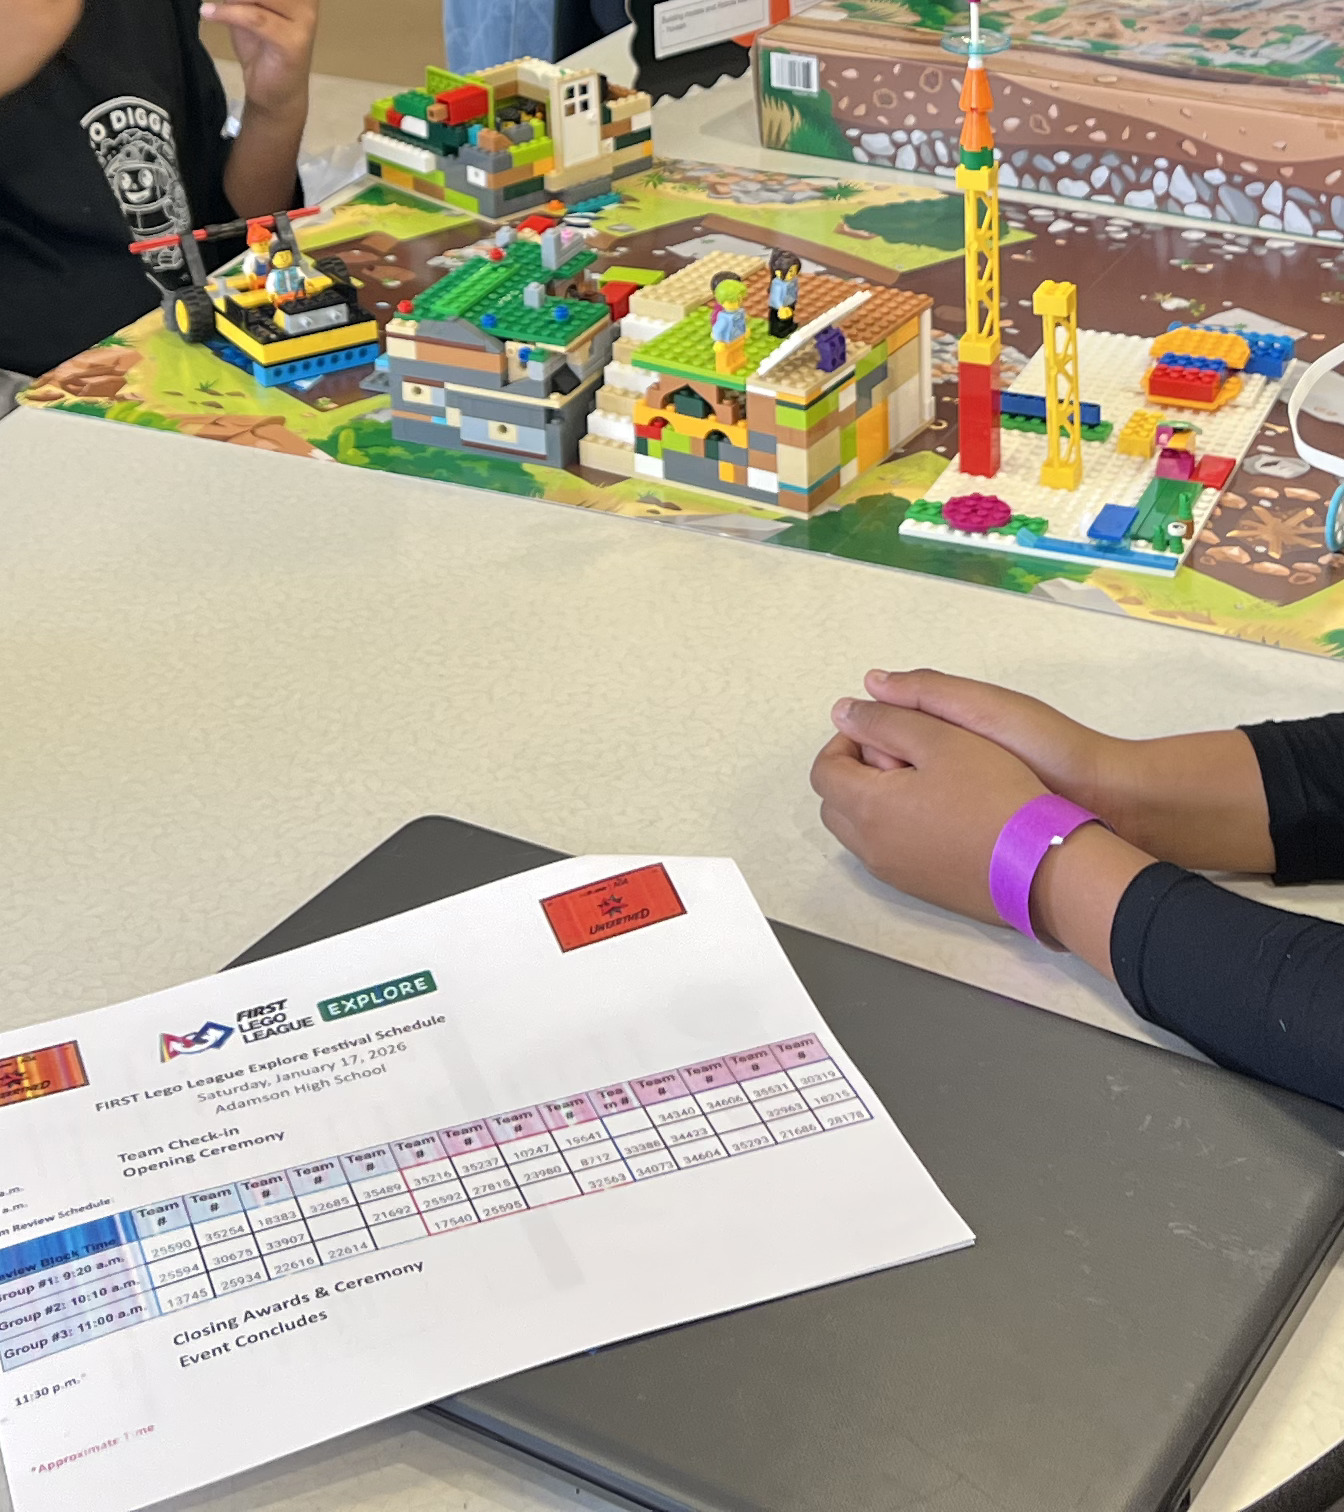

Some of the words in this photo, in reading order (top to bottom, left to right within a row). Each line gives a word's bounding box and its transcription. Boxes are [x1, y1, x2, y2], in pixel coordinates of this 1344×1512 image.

[109, 106, 172, 140] DIGGE
[237, 998, 288, 1022] FIRST
[327, 976, 429, 1017] EXPLORE
[237, 1012, 287, 1034] LEGO
[242, 1016, 315, 1044] LEAGUE
[95, 1092, 141, 1112] FIRST
[145, 1084, 182, 1101] Lego
[187, 1068, 244, 1090] League
[249, 1052, 309, 1074] Explore
[312, 1033, 373, 1057] Festival
[375, 1014, 447, 1042] Schedule
[197, 1077, 272, 1103] Saturday,
[275, 1061, 337, 1084] January
[342, 1054, 365, 1068] 17,
[368, 1041, 408, 1061] 2026
[215, 1089, 291, 1115] Adamson
[295, 1078, 332, 1094] High
[334, 1063, 388, 1084] School
[117, 1144, 165, 1164] Team
[168, 1126, 241, 1151] Check-in
[137, 1201, 180, 1218] Team
[190, 1187, 233, 1204] Team
[241, 1174, 284, 1191] Team
[293, 1161, 335, 1178] Team
[345, 1148, 387, 1164] Team
[396, 1135, 437, 1152] Team
[444, 1123, 484, 1138] Team
[493, 1110, 534, 1126] Team
[544, 1097, 585, 1113] Team
[636, 1072, 677, 1089] Team
[683, 1061, 723, 1077] Team
[729, 1049, 769, 1065] Team
[776, 1037, 815, 1053] Team
[123, 1151, 197, 1178] Opening
[199, 1130, 286, 1159] Ceremony
[2, 1202, 29, 1214] a.m.
[12, 1215, 56, 1234] Review
[38, 1275, 60, 1289] #1:
[62, 1264, 93, 1282] 9:20
[95, 1255, 126, 1269] a.m.
[40, 1250, 80, 1269] Block
[83, 1238, 117, 1256] Time
[45, 1302, 67, 1316] #2:
[71, 1287, 109, 1307] 10:10
[111, 1277, 141, 1294] a.m.
[158, 1263, 200, 1284] 25594
[265, 1233, 306, 1252] 33907
[3, 1336, 49, 1360] Group
[51, 1328, 74, 1344] #3:
[77, 1314, 115, 1333] 11:00
[117, 1303, 148, 1320] a.m.
[167, 1287, 209, 1309] 13745
[219, 1271, 262, 1291] 25934
[172, 1316, 240, 1346] Closing
[243, 1293, 311, 1324] Awards
[314, 1285, 331, 1300] &
[333, 1260, 425, 1293] Ceremony
[179, 1340, 232, 1368] Event
[235, 1308, 329, 1348] Concludes
[14, 1386, 50, 1407] 11:30
